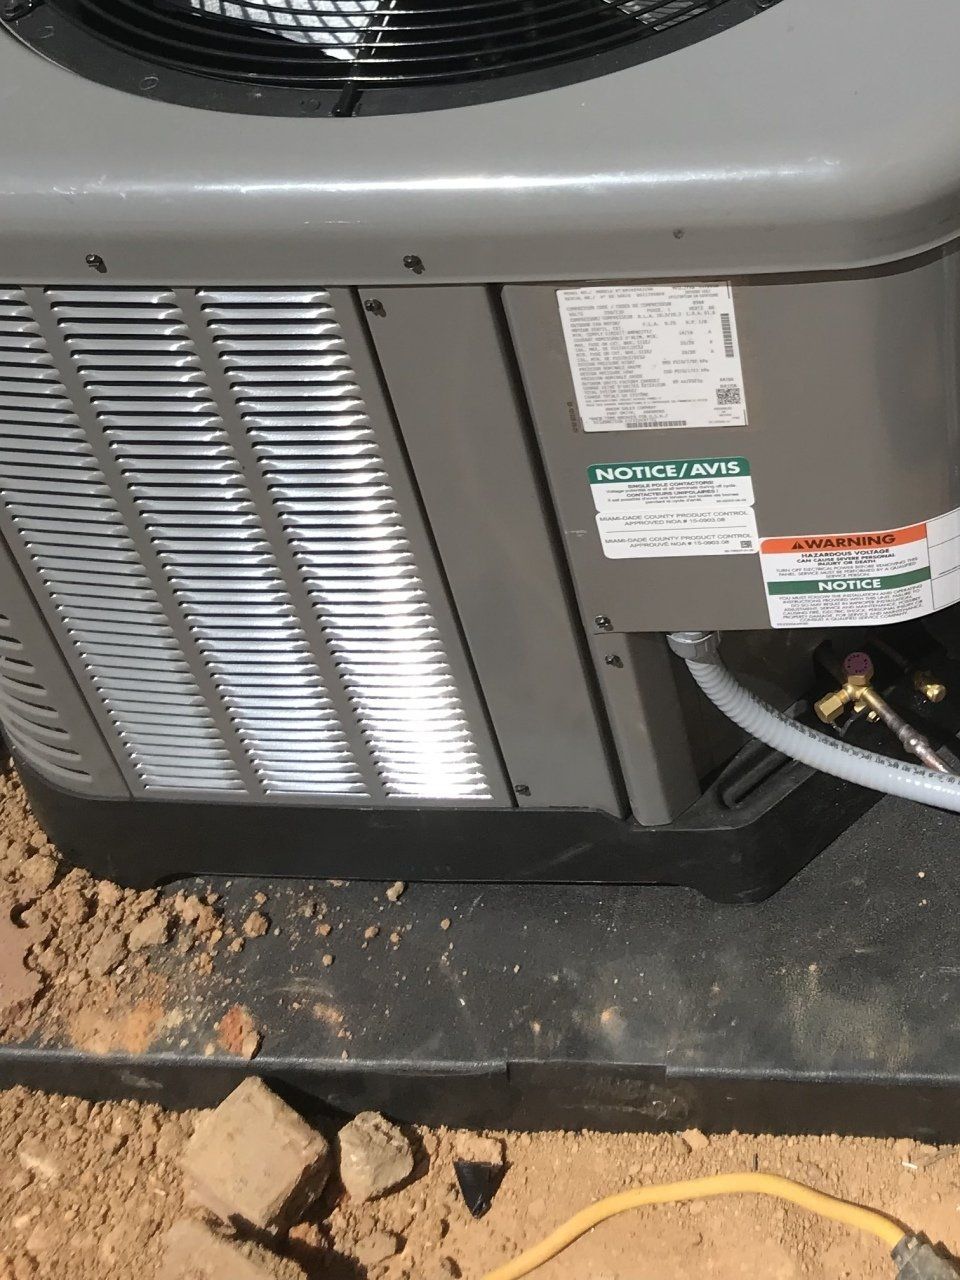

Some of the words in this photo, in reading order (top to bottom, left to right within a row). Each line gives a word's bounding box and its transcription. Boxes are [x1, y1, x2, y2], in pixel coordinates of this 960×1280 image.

[595, 461, 741, 481] NOTICE/AVIS
[804, 534, 896, 548] WARNING
[818, 578, 881, 591] NOTICE
